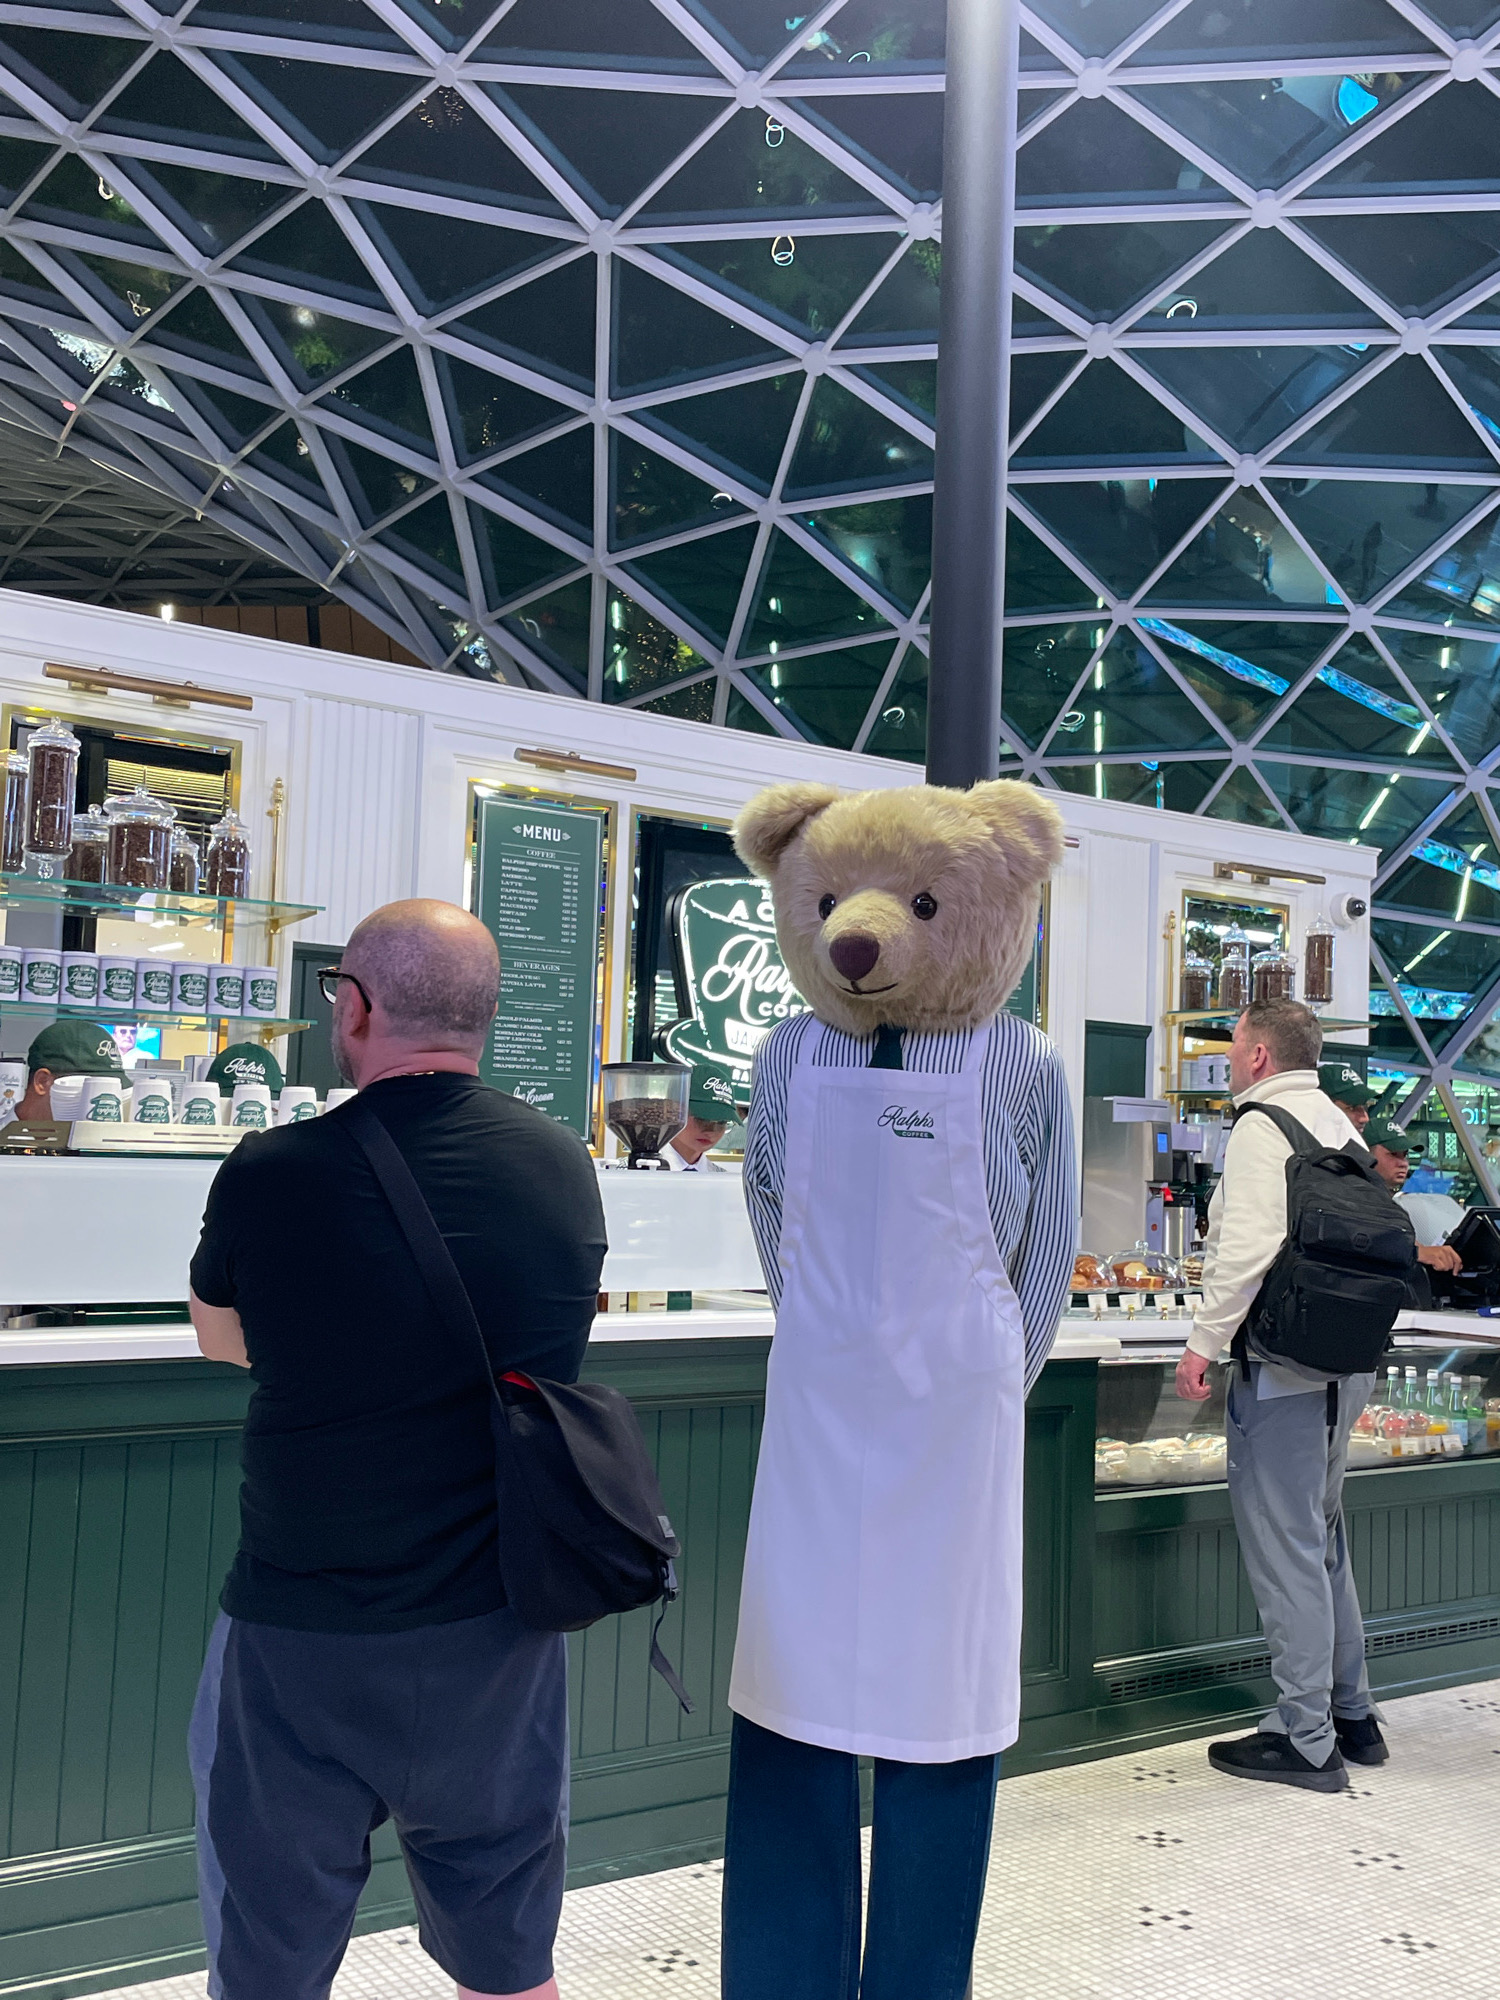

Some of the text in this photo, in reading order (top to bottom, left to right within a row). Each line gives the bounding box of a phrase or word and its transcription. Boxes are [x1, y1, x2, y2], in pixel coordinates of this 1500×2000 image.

[522, 824, 561, 842] MENU
[526, 849, 556, 859] COFFEE
[501, 872, 537, 881] AMERICANO
[500, 887, 538, 896] CAPPUCCINO
[499, 902, 537, 910] MACCHIATO
[513, 961, 561, 971] BEVERAGES
[223, 1057, 266, 1077] Ralph's
[526, 1087, 554, 1105] Cream
[877, 1104, 935, 1132] Ralph's
